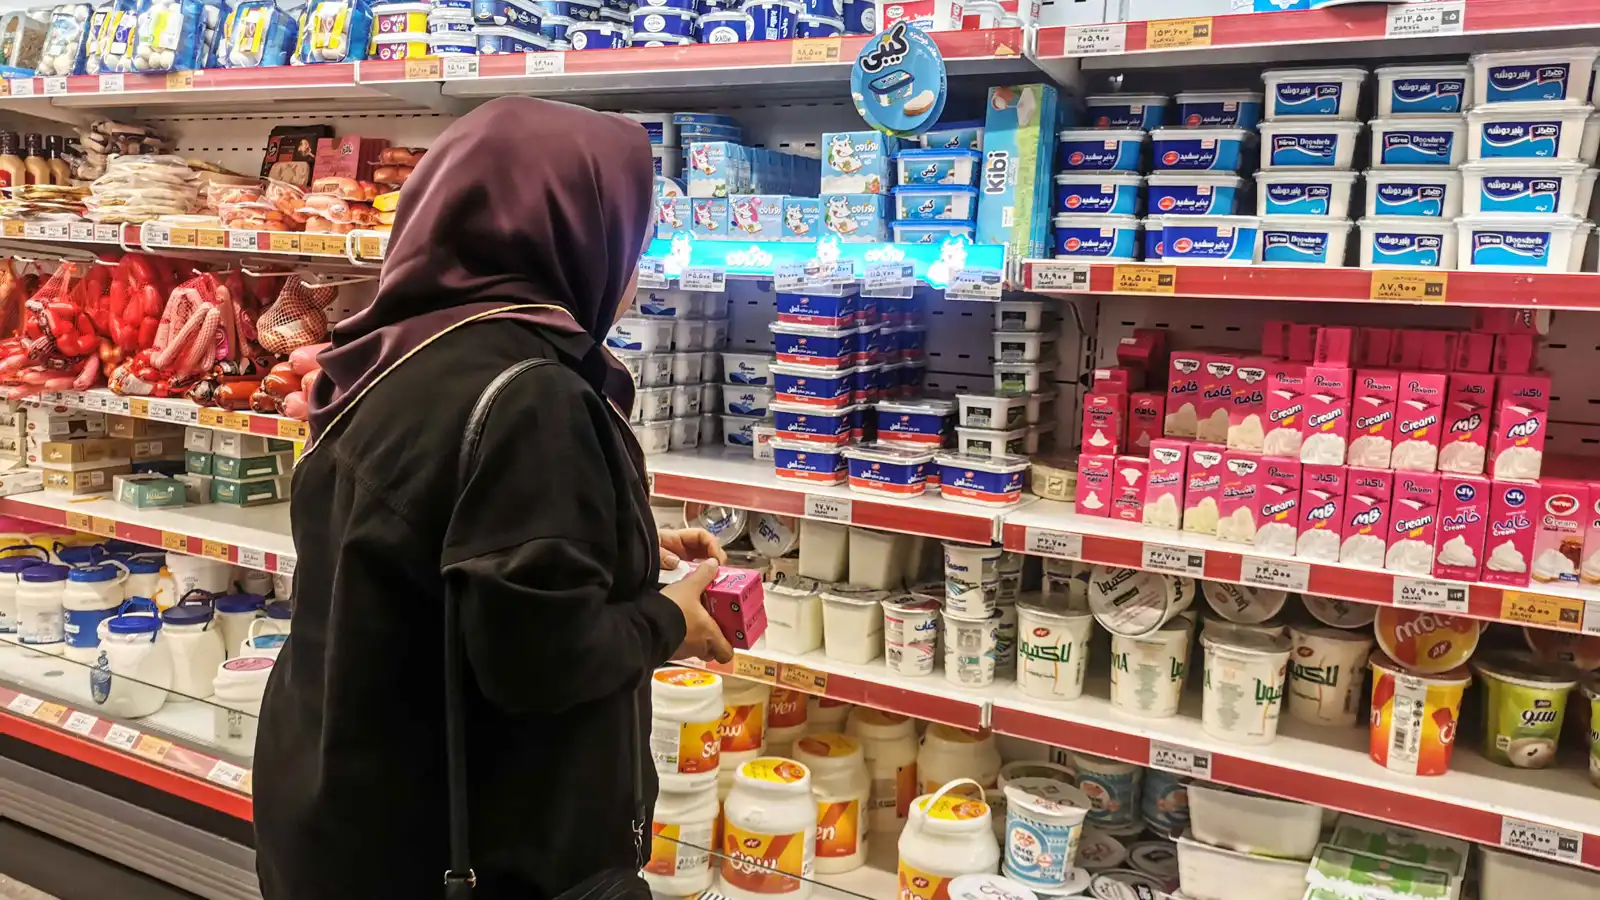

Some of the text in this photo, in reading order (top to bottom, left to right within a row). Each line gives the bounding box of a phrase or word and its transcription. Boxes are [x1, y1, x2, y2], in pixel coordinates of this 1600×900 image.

[860, 21, 909, 72] کیبی
[1517, 70, 1530, 80] پنیر
[1509, 126, 1524, 136] پنیر
[1084, 151, 1115, 162] پنیر سفید
[1180, 151, 1213, 162] پنیر سفید
[1509, 181, 1524, 191] پنیر
[1288, 187, 1301, 197] پنیر
[1400, 187, 1413, 197] پنیر
[1081, 195, 1112, 206] پنیر سفید
[1175, 197, 1209, 207] پنیر سفید
[1081, 239, 1112, 249] پنیر سفید
[1194, 239, 1230, 250] پنیر سفید
[1398, 237, 1410, 247] پنیر
[1171, 381, 1198, 394] خامه
[1204, 385, 1231, 399] خامه
[1234, 391, 1263, 405] خامه
[1269, 404, 1303, 422] Cream
[1308, 407, 1343, 427] Cream
[1356, 410, 1392, 430] Cream
[1400, 415, 1437, 434] Cream
[1261, 499, 1296, 517] Cream
[1443, 508, 1481, 525] خامه
[1493, 513, 1531, 531] خامه
[1395, 514, 1432, 534] Cream
[1443, 523, 1466, 531] Cream
[1492, 528, 1516, 537] Cream
[1520, 709, 1558, 727] سبو
